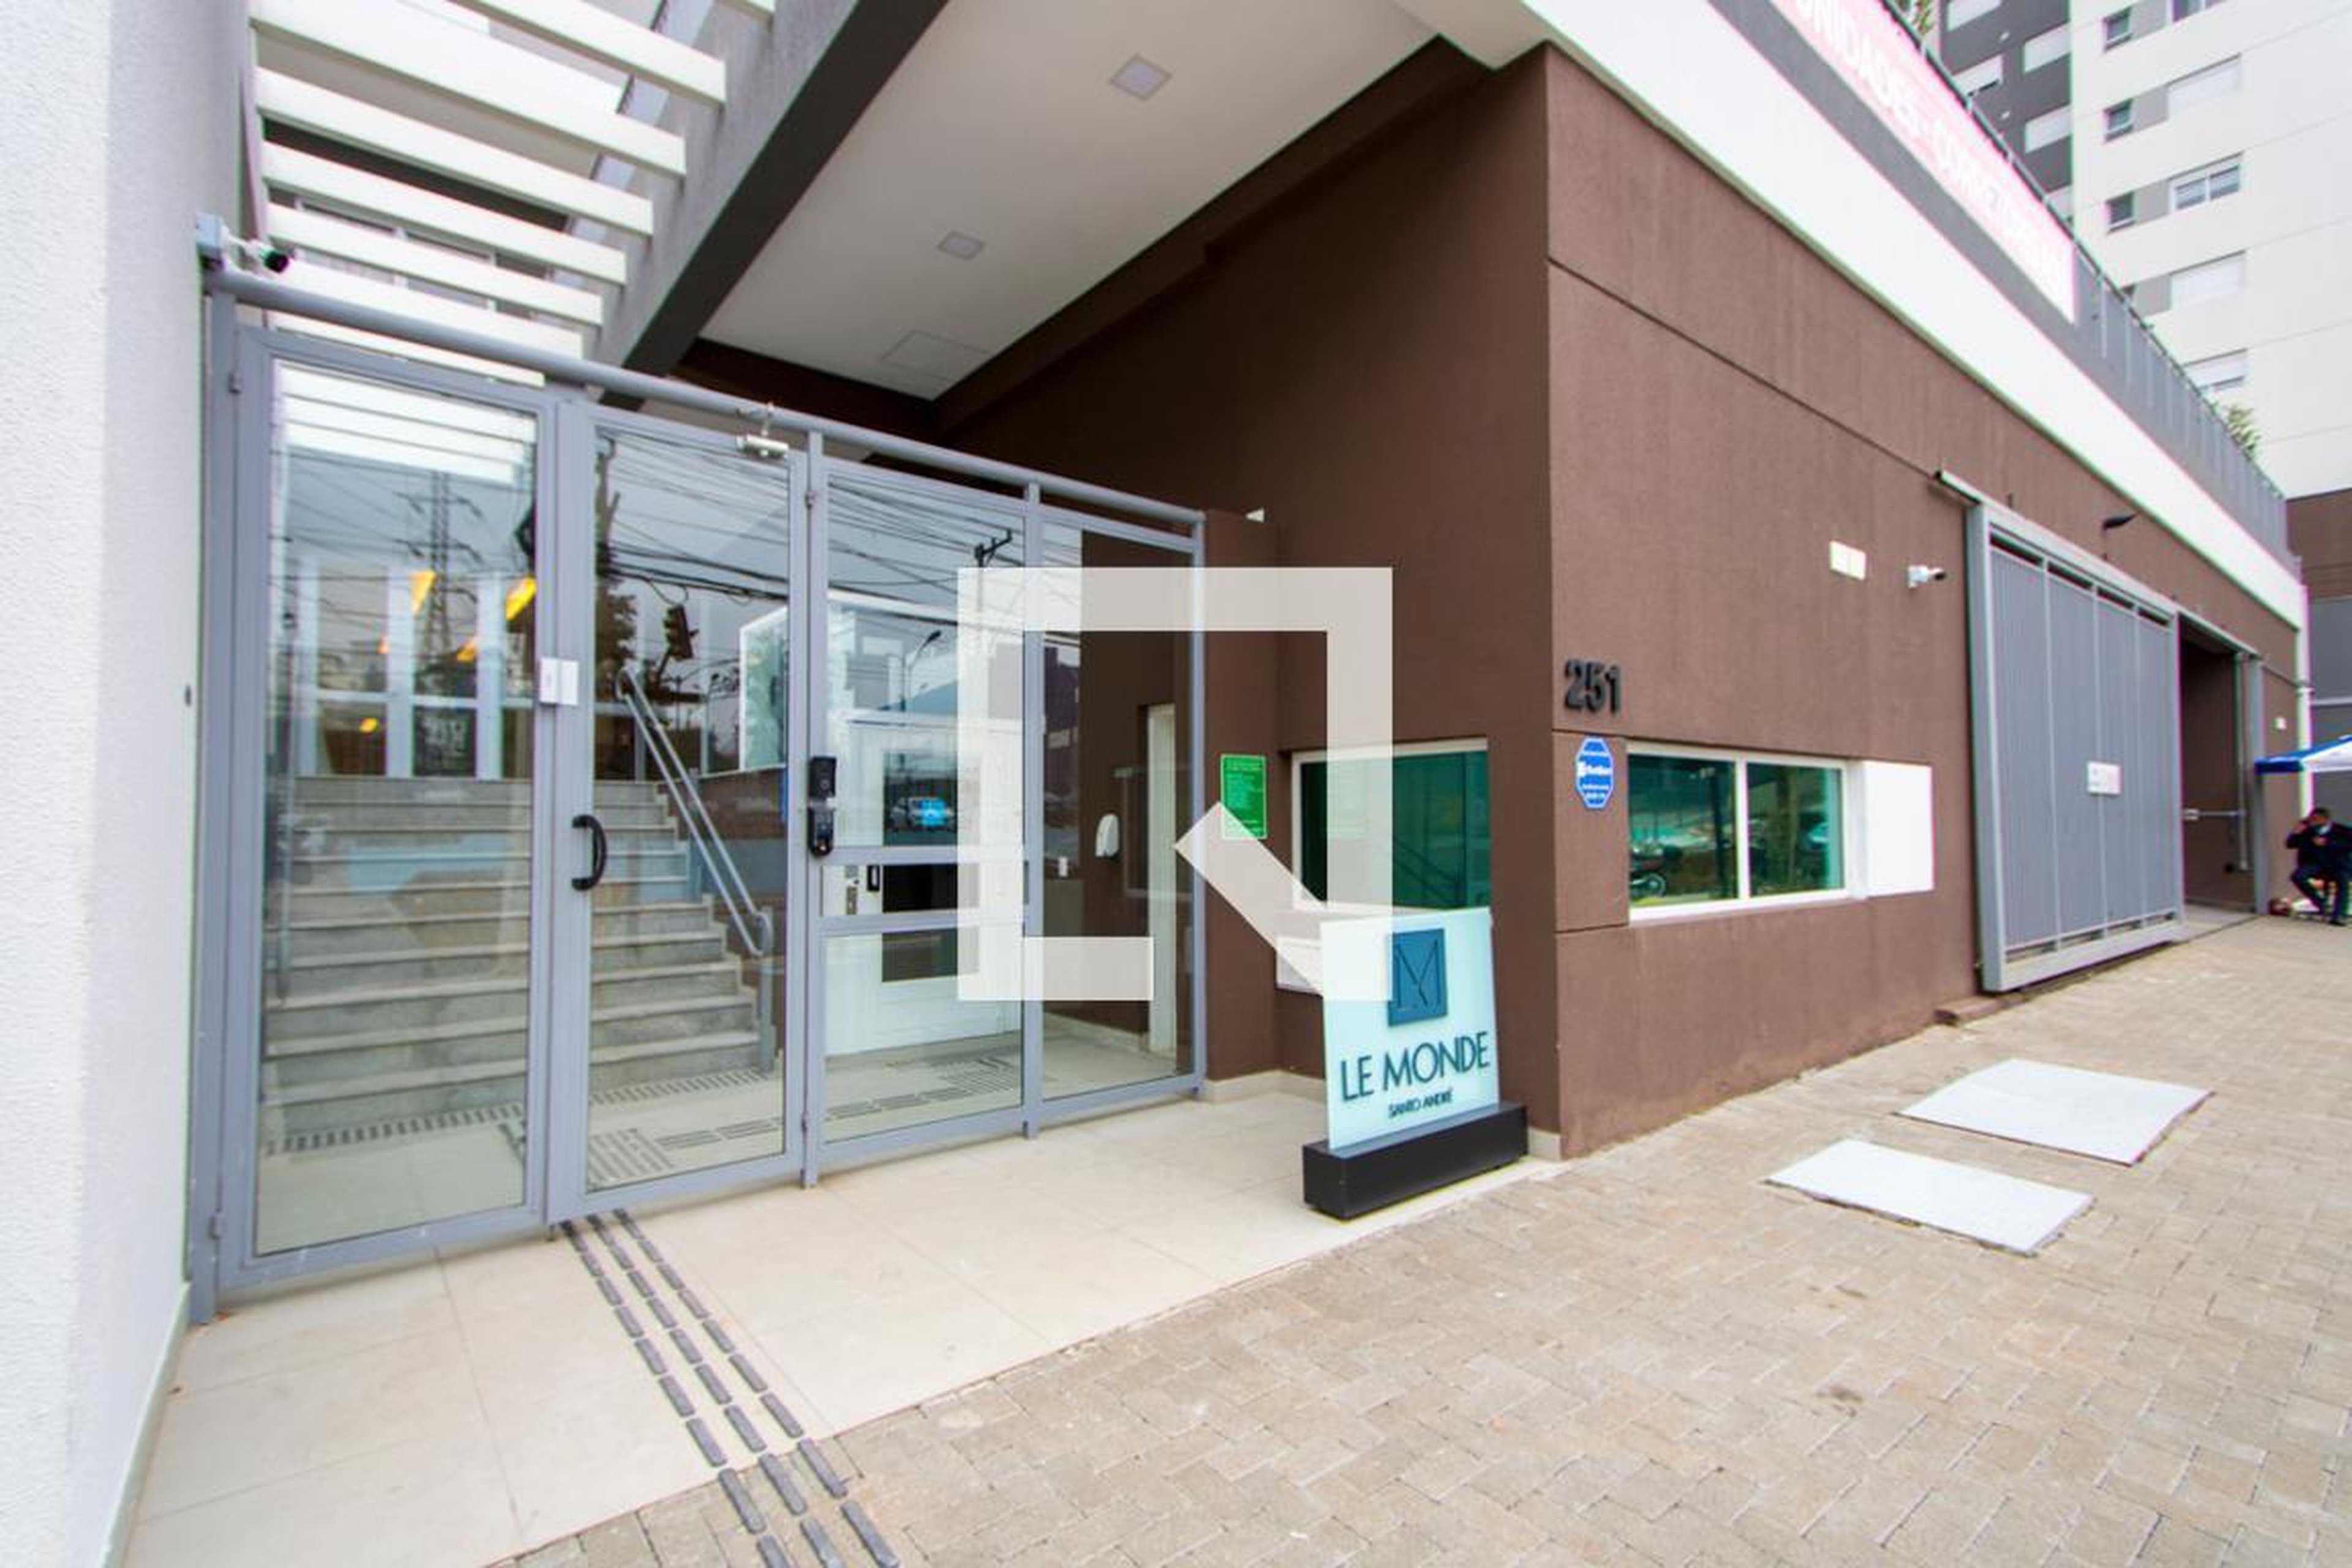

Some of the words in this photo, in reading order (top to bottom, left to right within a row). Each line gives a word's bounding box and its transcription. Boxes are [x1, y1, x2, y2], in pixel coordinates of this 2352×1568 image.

[1564, 658, 1621, 715] 251
[1341, 1055, 1374, 1101] LE
[1383, 1031, 1491, 1091] MONDE
[1389, 1098, 1421, 1118] SANTO
